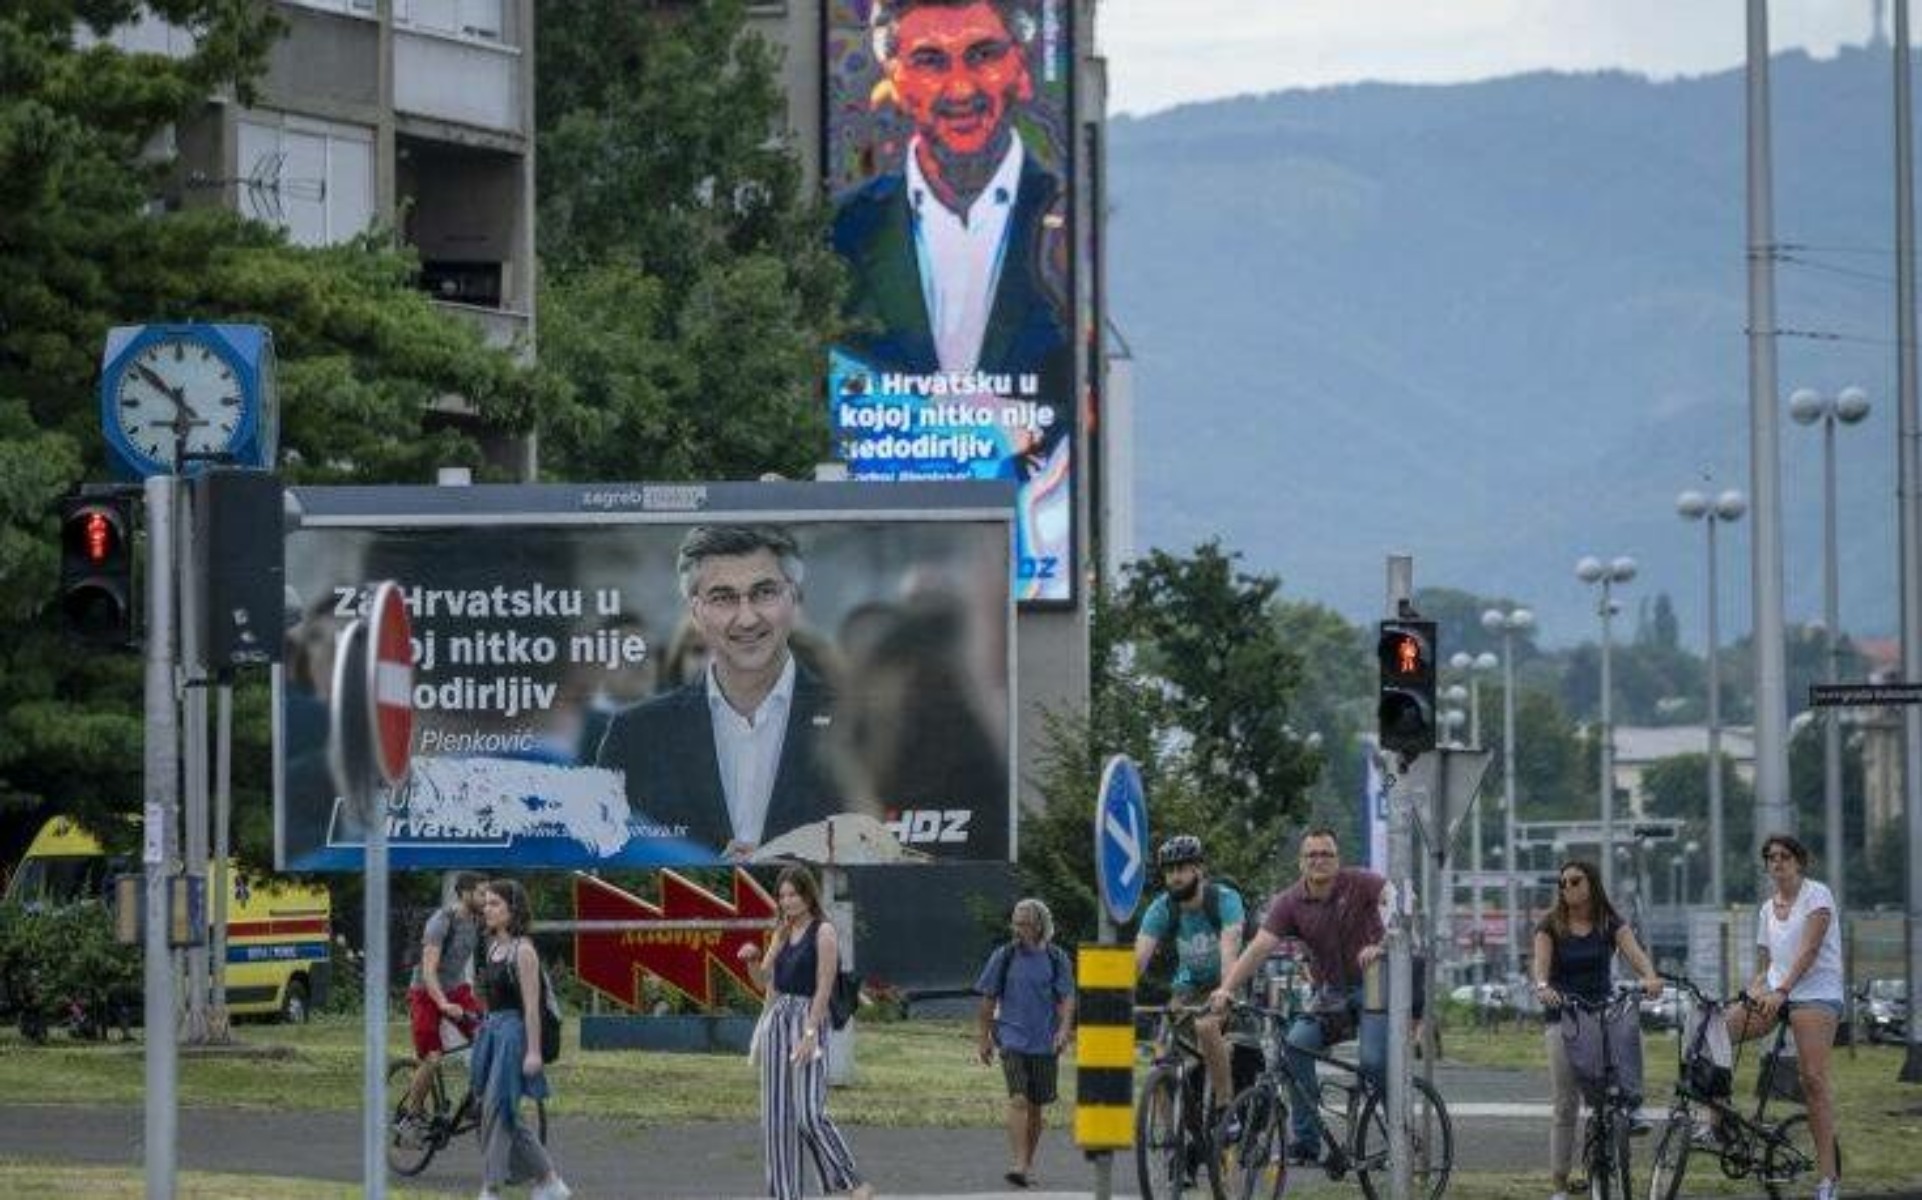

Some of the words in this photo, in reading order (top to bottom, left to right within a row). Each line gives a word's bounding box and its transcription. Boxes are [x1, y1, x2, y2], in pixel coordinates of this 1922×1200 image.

[882, 373, 1010, 395] Hrvatsku
[1020, 374, 1038, 394] u
[840, 404, 911, 430] kojoj
[919, 404, 994, 427] nitko
[1003, 404, 1055, 430] nije
[1017, 557, 1058, 578] DZ
[399, 583, 581, 618] Hrvatsku
[599, 588, 621, 617] u
[449, 630, 556, 664] nitko
[569, 630, 648, 669] nije
[413, 676, 557, 717] odirljiv
[419, 728, 535, 753] Plenković
